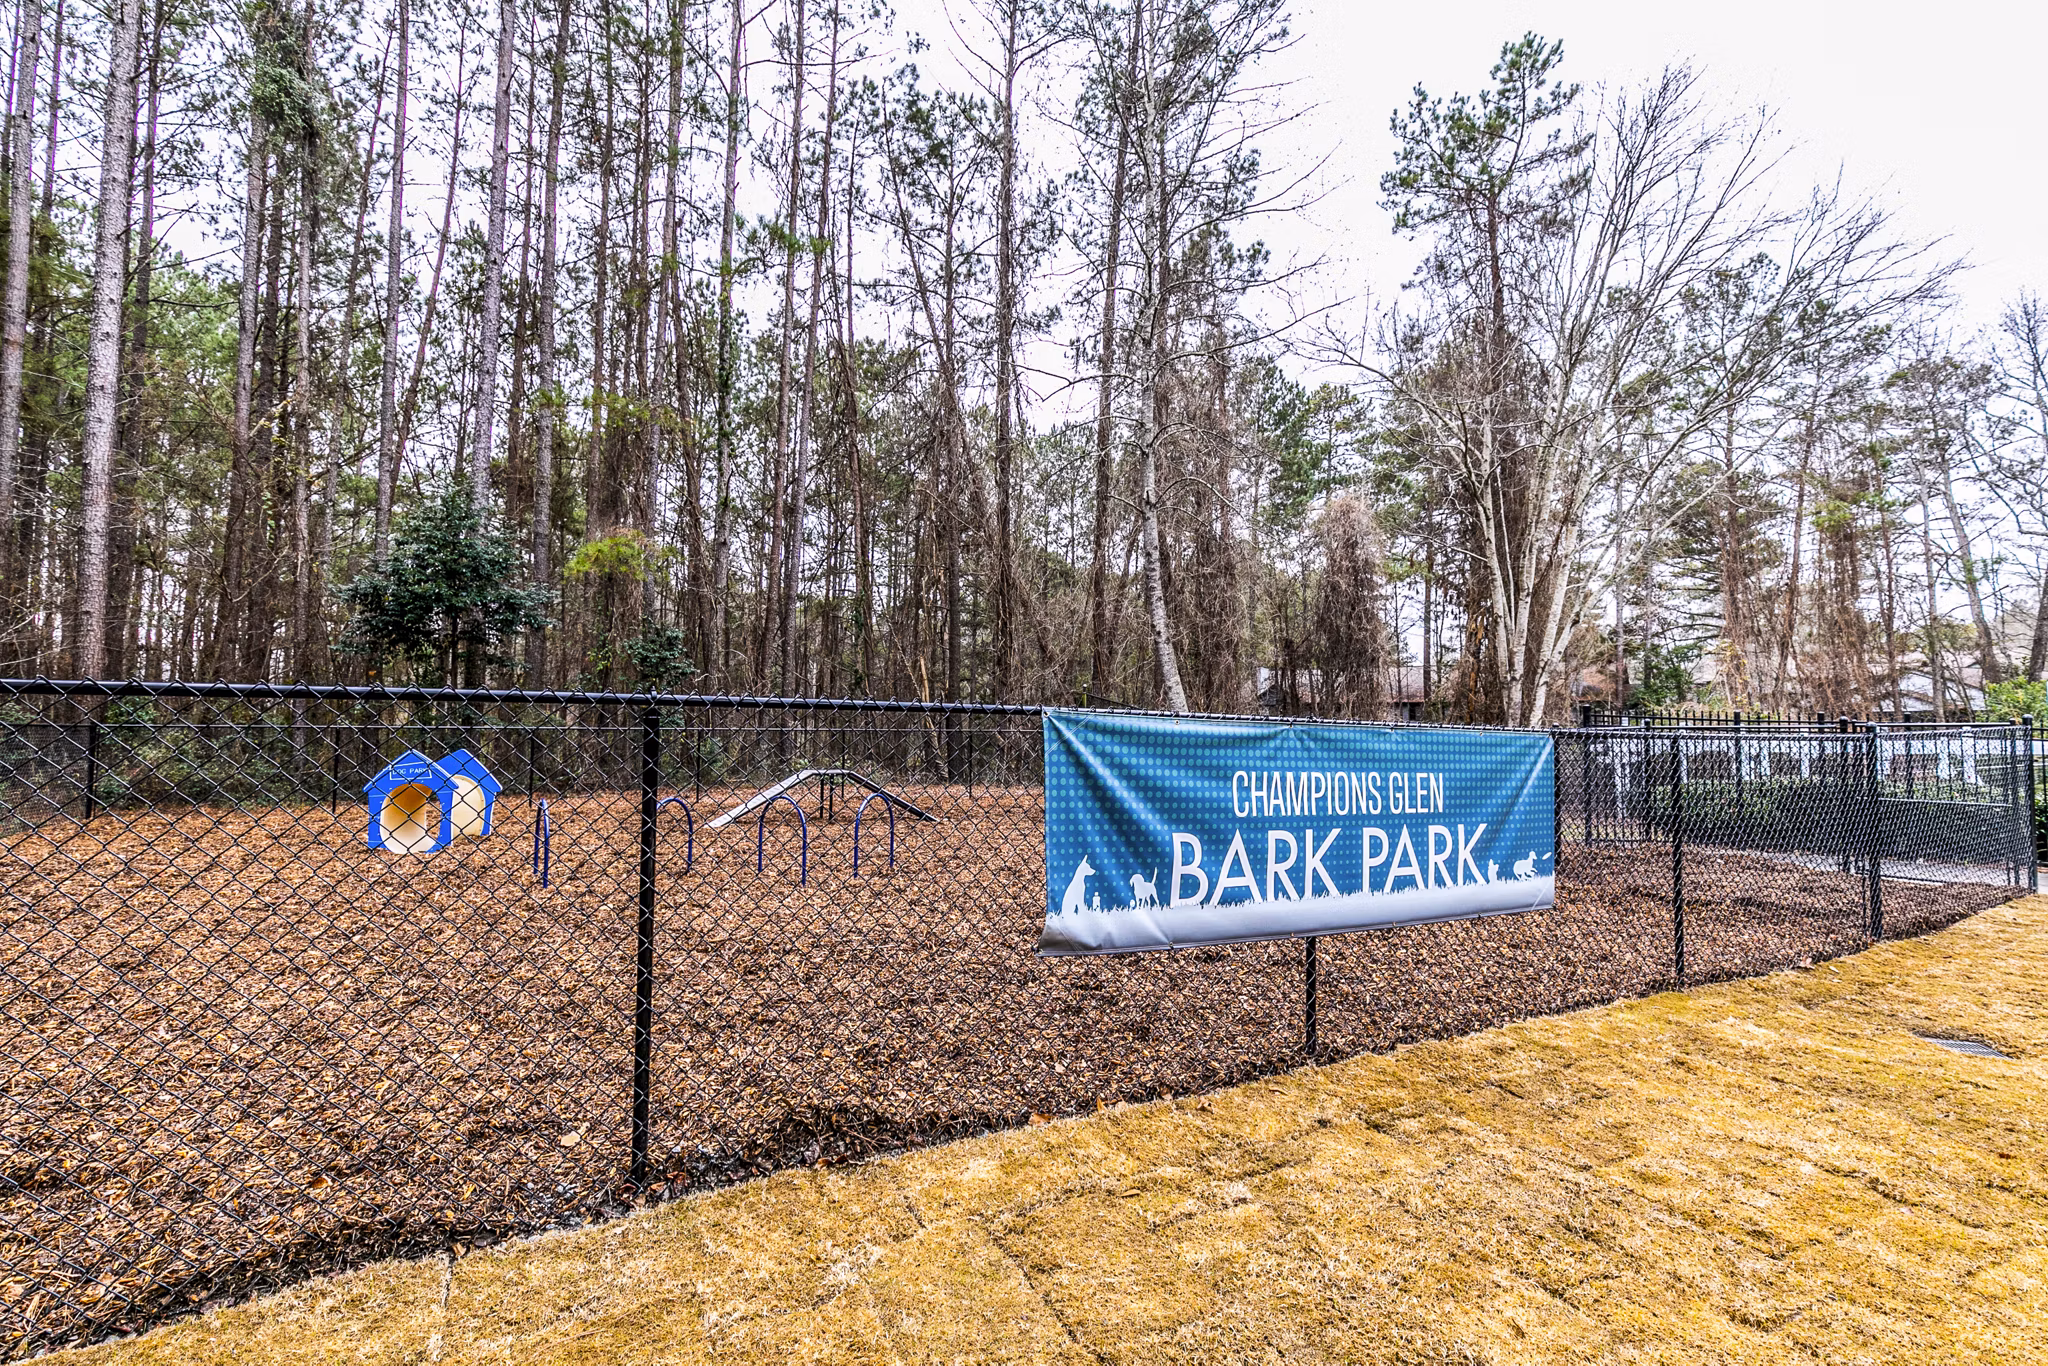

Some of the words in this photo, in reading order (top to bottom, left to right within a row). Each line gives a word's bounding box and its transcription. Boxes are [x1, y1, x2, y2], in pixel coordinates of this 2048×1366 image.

[1232, 770, 1382, 818] CHAMPIONS
[1389, 771, 1444, 814] GLEN
[1170, 828, 1342, 908] BARK
[1362, 823, 1488, 894] PARK
